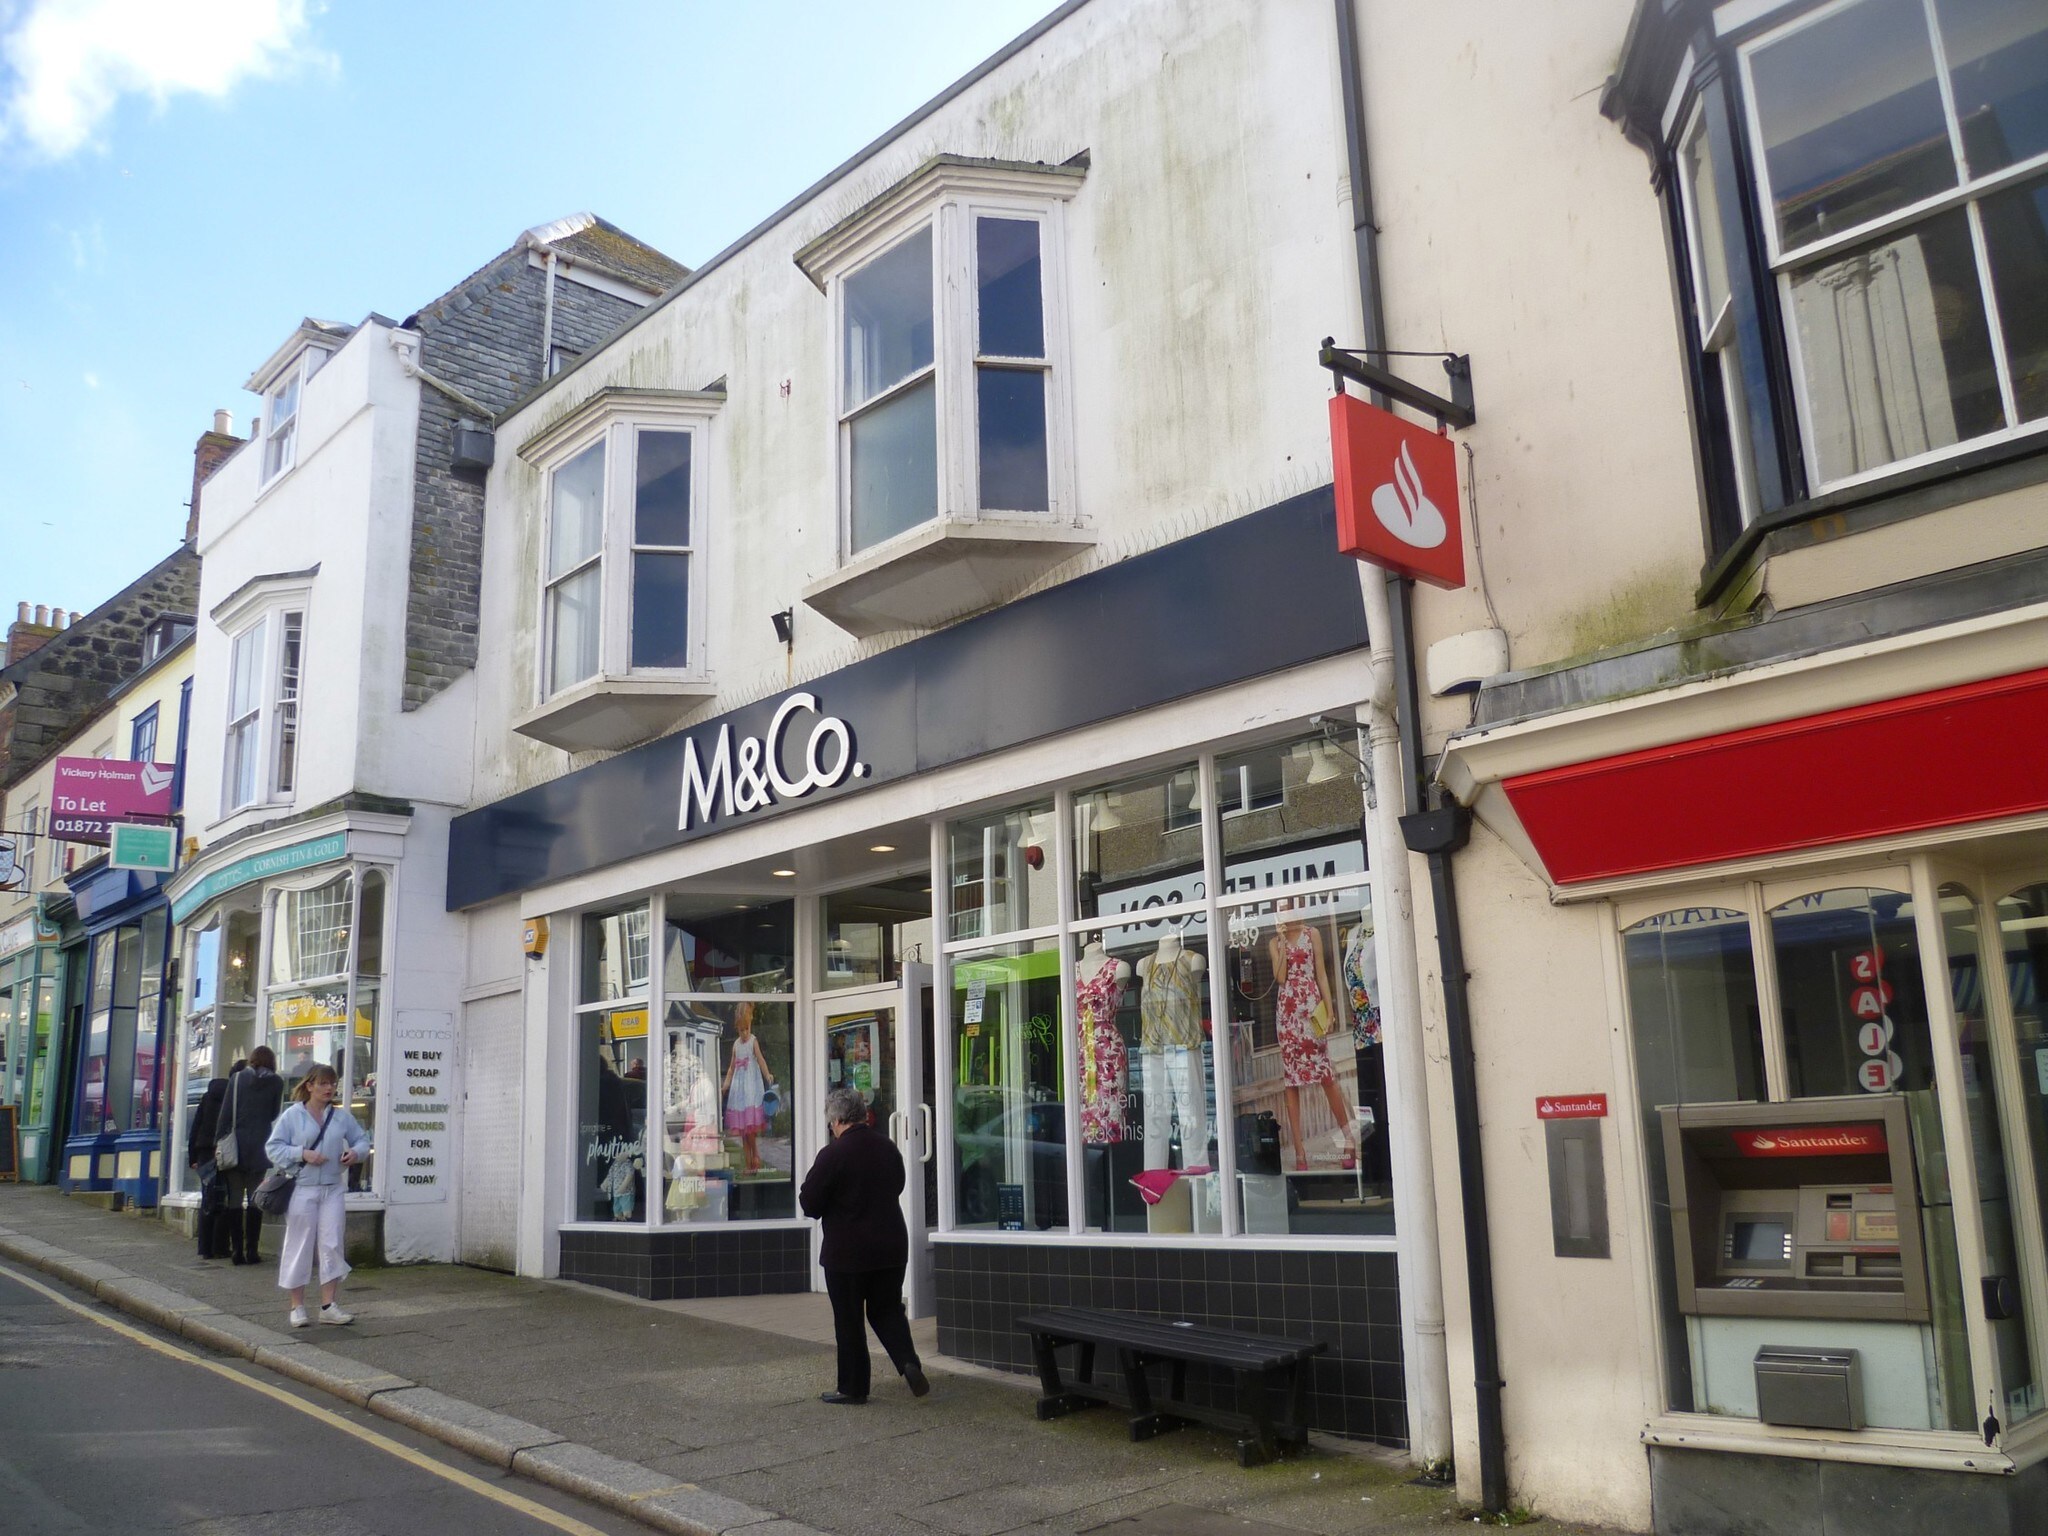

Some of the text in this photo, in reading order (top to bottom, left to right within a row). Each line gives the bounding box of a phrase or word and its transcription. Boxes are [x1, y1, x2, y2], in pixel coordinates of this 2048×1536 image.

[678, 692, 864, 831] M&Co.
[61, 767, 136, 780] Vickery Holman
[58, 796, 107, 812] To Let
[55, 819, 102, 834] 01872
[253, 852, 290, 874] CORNISH
[291, 849, 307, 864] TIN
[314, 841, 339, 857] GOLD
[1229, 926, 1259, 949] £39
[297, 1036, 314, 1046] SALE
[404, 1050, 442, 1060] WE BUY
[406, 1068, 440, 1078] SCRAP
[408, 1085, 437, 1096] GOLD
[393, 1103, 449, 1114] JEWELLERY
[1554, 1099, 1602, 1113] Santander
[397, 1121, 446, 1131] WATCHES
[1086, 1119, 1115, 1141] ook
[1120, 1116, 1144, 1141] this
[410, 1139, 431, 1149] FOR
[1777, 1133, 1869, 1149] Santander
[586, 1134, 642, 1167] playtime
[406, 1157, 435, 1167] CASH
[402, 1174, 437, 1185] TODAY
